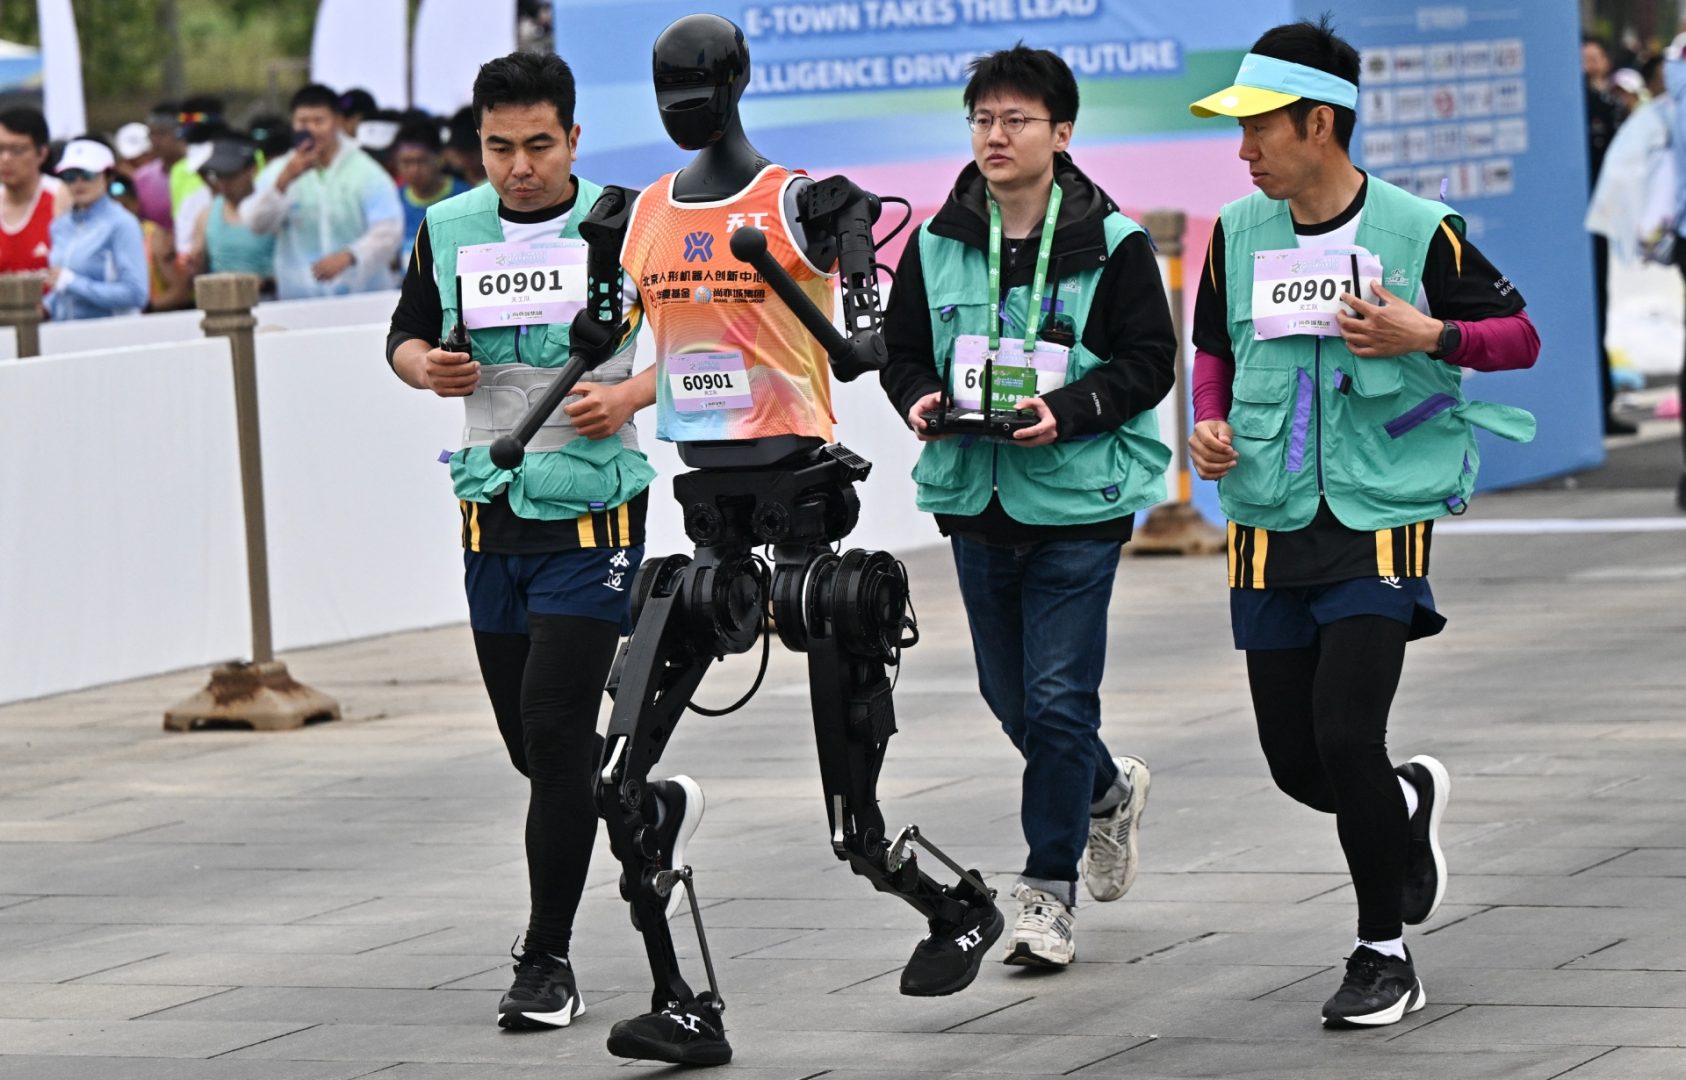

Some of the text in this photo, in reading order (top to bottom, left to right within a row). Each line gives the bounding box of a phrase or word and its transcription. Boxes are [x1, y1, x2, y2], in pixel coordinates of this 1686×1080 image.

[746, 0, 1097, 36] E-TOWN TAKES THE LEAD
[726, 212, 769, 233] 天工
[478, 270, 563, 296] 60901
[1272, 278, 1352, 304] 60901
[683, 373, 733, 391] 60901
